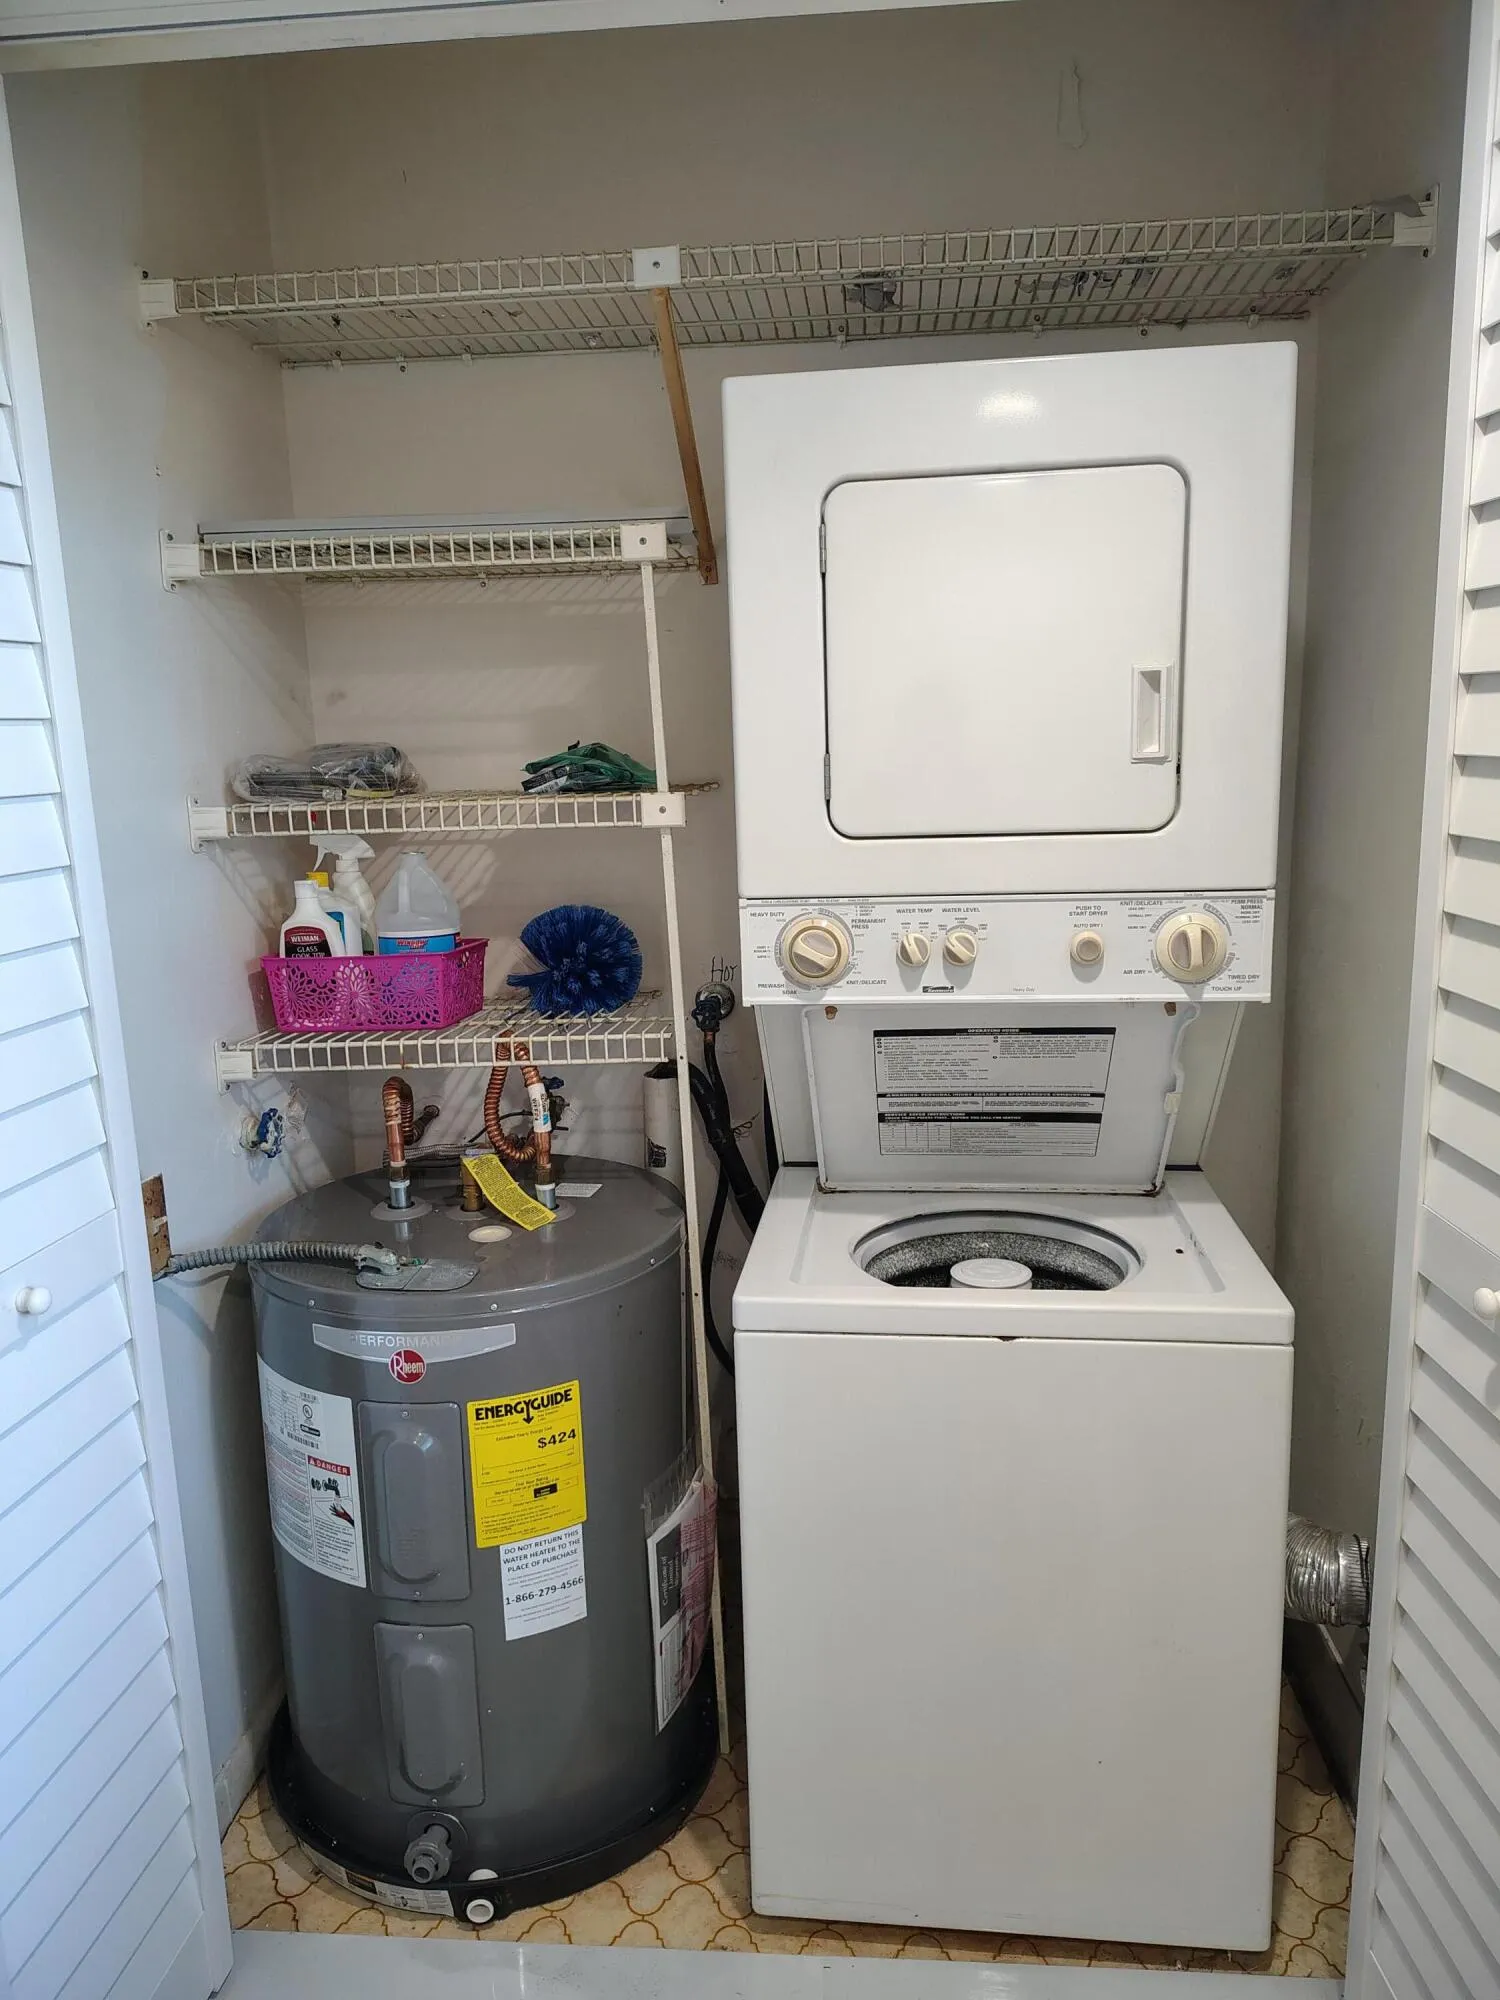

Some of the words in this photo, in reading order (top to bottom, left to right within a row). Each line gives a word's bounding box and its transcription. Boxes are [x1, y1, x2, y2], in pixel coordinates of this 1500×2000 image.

[393, 1350, 425, 1378] Rheem
[475, 1388, 573, 1422] ENERGYGUIDE
[537, 1428, 577, 1449] $424
[316, 1460, 348, 1474] DANGER
[503, 1554, 528, 1565] WATER
[529, 1545, 556, 1558] HEATER
[556, 1542, 567, 1551] TO
[568, 1538, 580, 1547] THE
[504, 1547, 516, 1555] DO
[517, 1543, 533, 1552] NOT
[534, 1536, 563, 1547] RETURN
[563, 1529, 579, 1538] THIS
[507, 1563, 529, 1573] PLACE
[542, 1548, 578, 1565] PURCHASE
[505, 1575, 584, 1605] 1-866-279-4566
